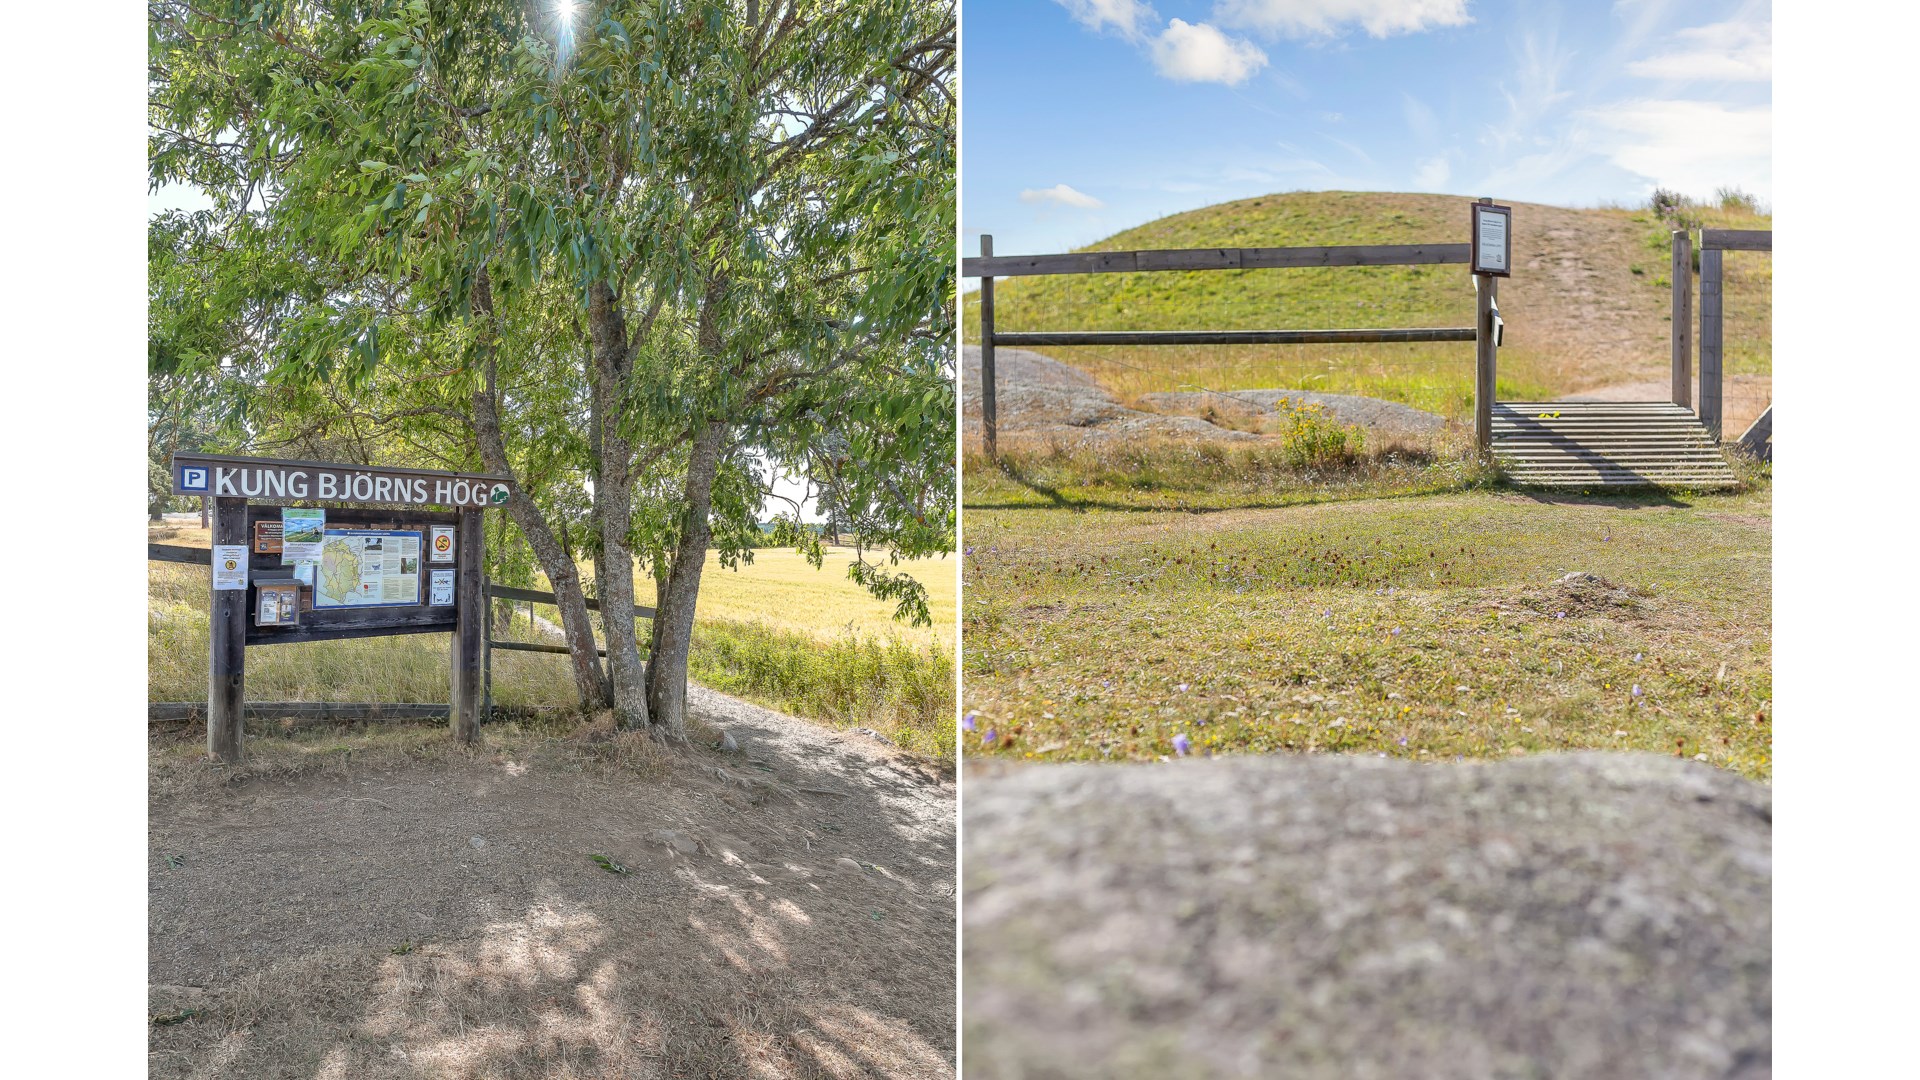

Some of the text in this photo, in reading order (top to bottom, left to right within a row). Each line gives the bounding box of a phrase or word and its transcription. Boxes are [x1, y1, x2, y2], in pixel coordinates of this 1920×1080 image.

[188, 471, 201, 485] P
[216, 467, 488, 506] KUNG BJÖRNS HÖG
